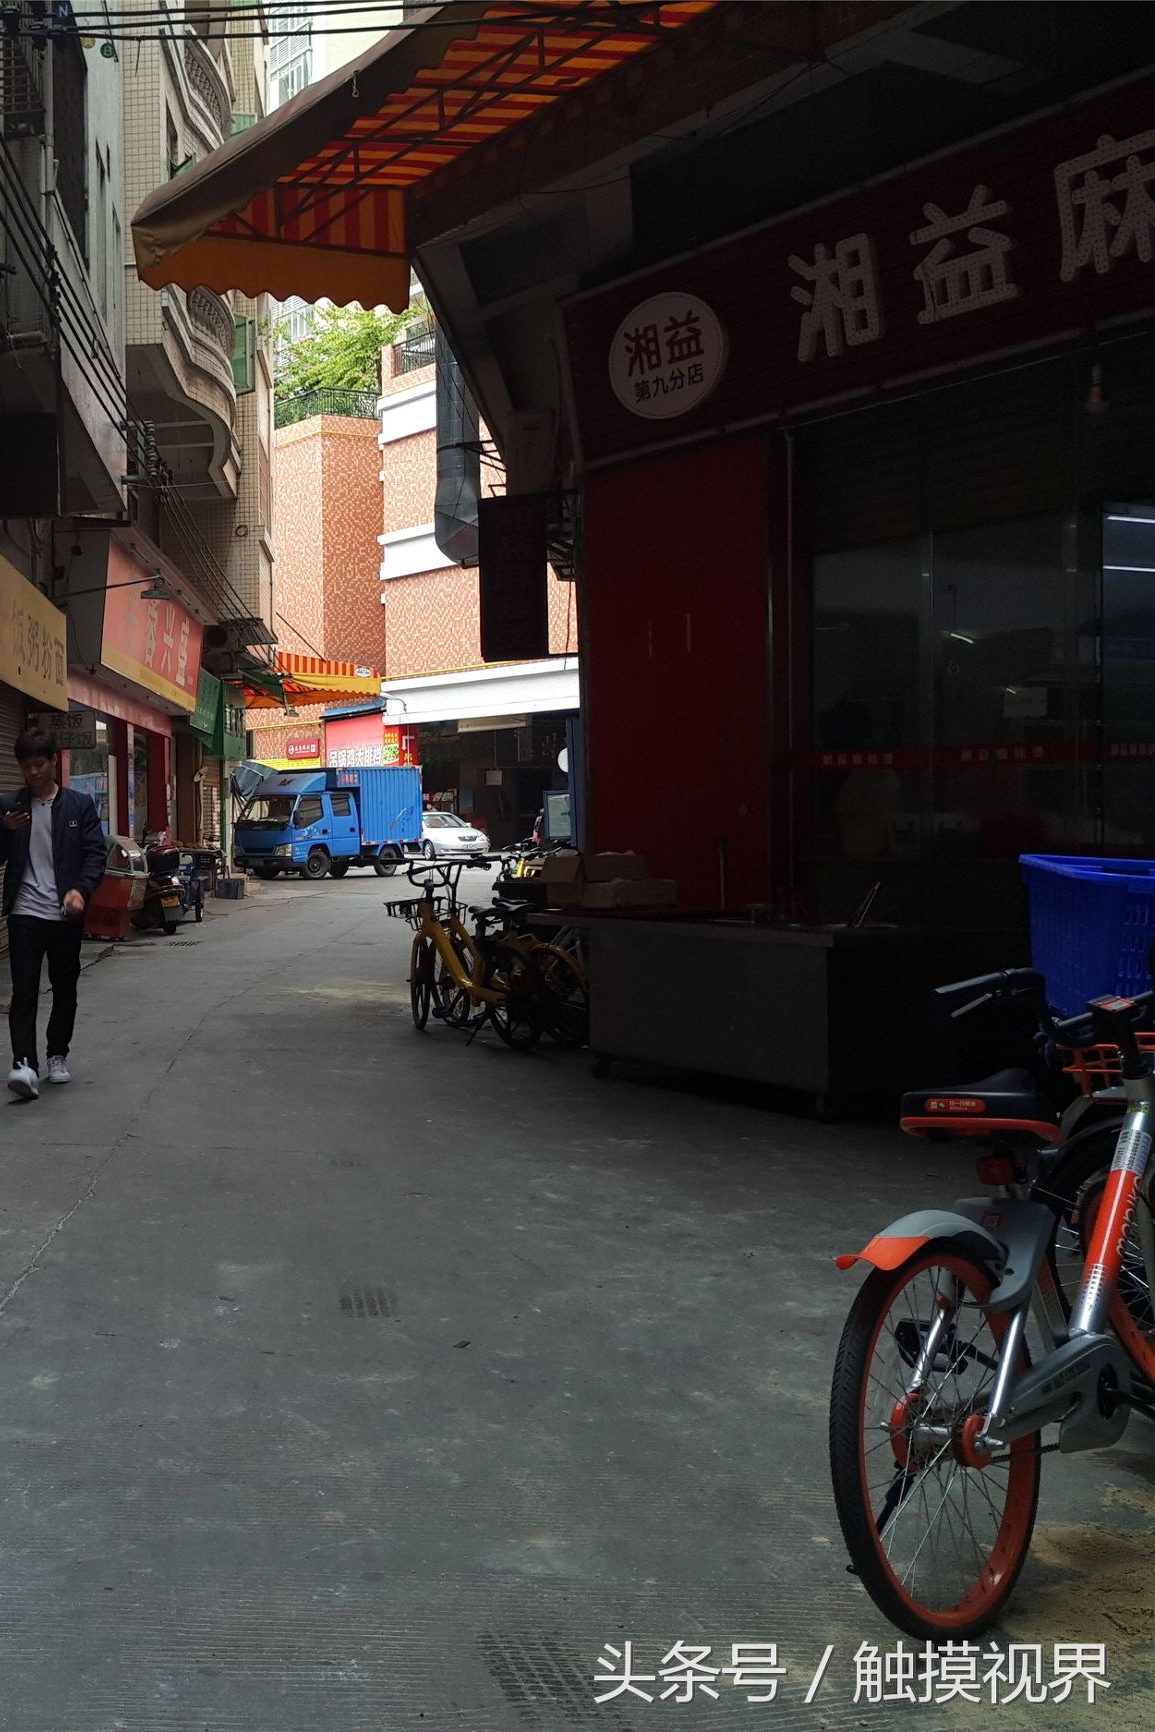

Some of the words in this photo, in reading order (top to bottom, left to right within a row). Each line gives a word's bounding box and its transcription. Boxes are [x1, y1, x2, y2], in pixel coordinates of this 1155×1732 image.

[623, 310, 705, 377] 湘益
[634, 363, 704, 403] 第九分店
